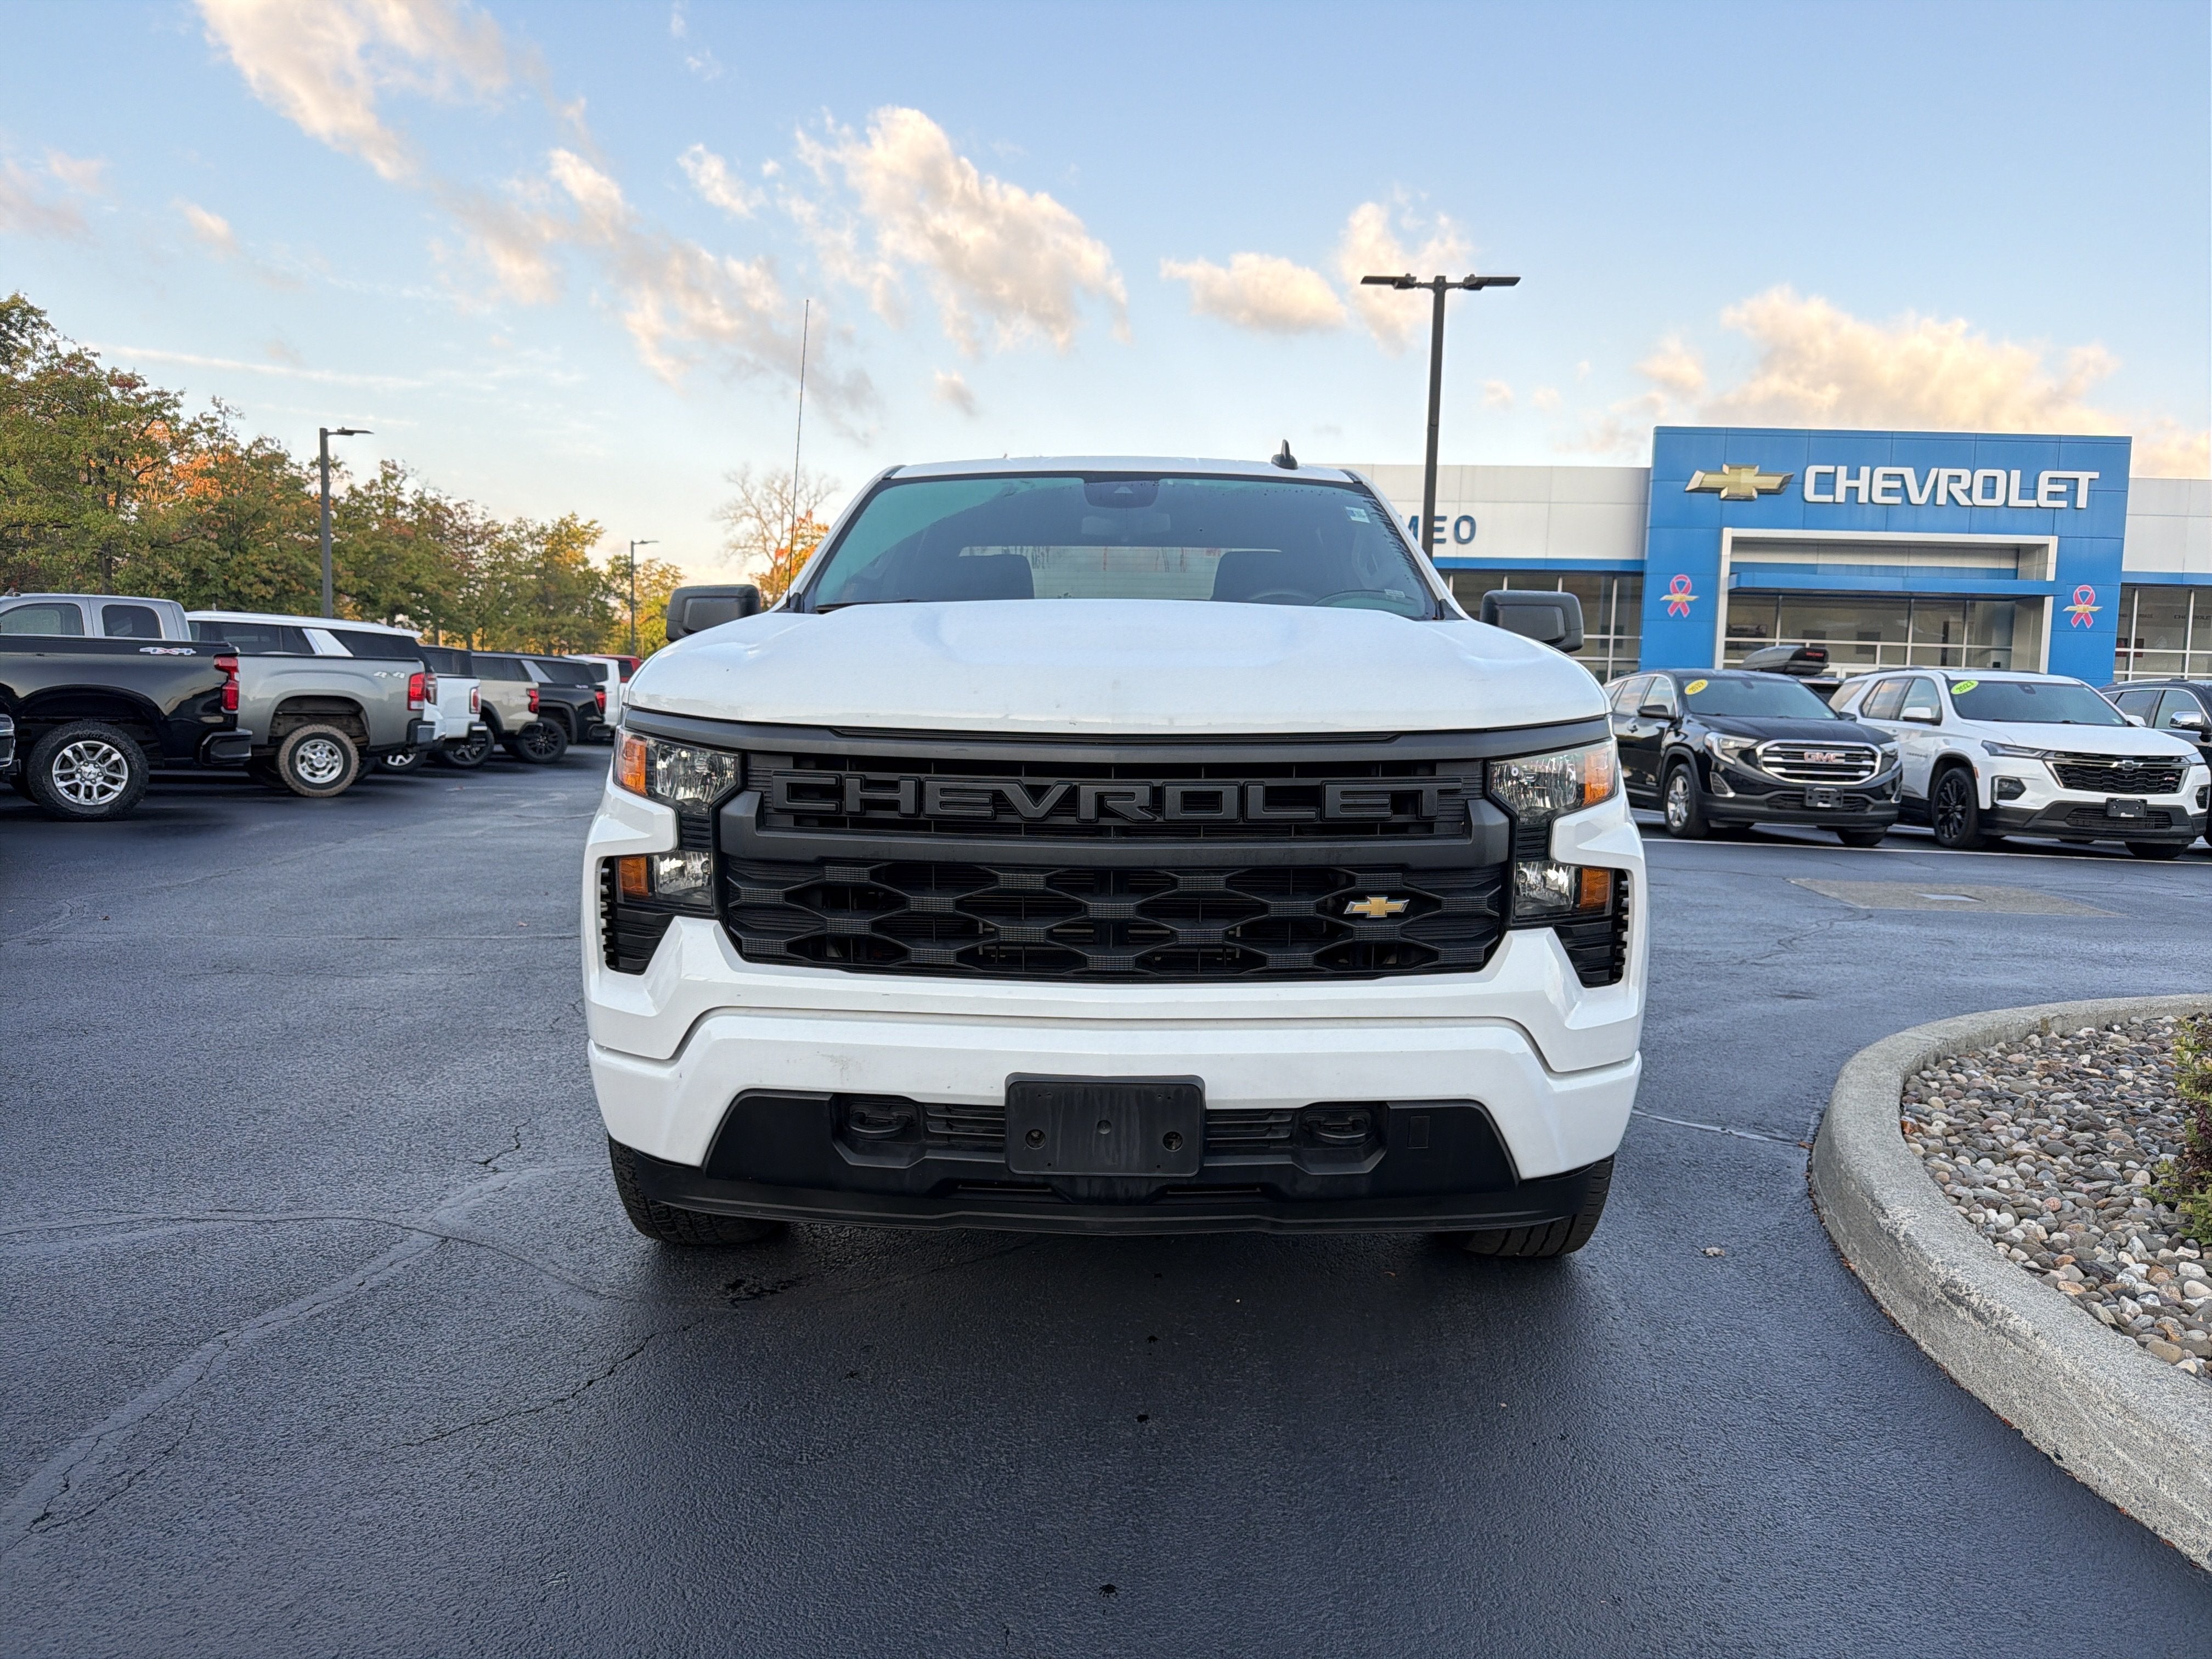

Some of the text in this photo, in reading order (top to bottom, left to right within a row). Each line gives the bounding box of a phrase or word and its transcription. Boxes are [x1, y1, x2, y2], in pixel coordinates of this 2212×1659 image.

[1804, 465, 2100, 509] CHEVROLET
[1803, 751, 1846, 764] GMC
[771, 770, 1464, 822] CHEVROLET
